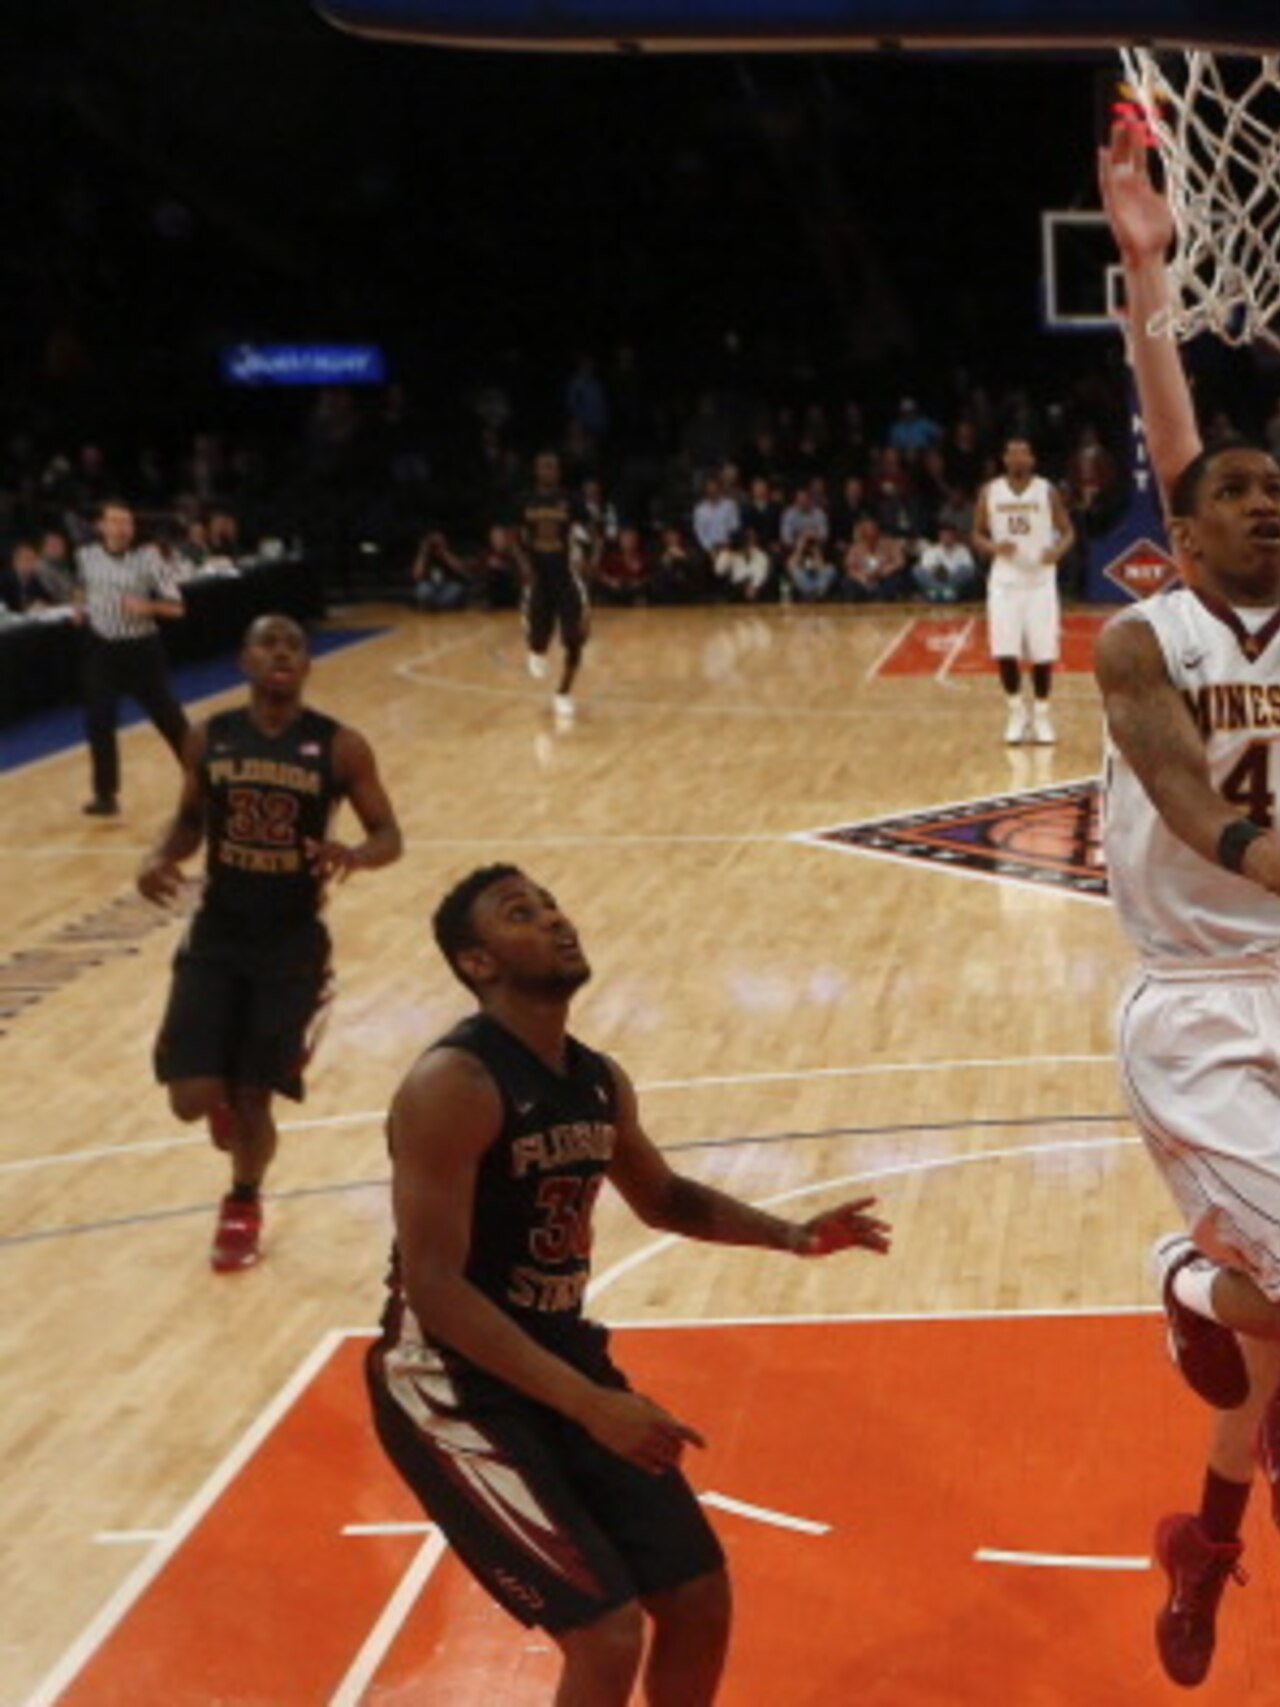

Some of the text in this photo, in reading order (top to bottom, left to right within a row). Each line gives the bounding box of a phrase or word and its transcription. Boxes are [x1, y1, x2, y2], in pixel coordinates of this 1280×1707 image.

[209, 757, 320, 795] FLORIDA
[1221, 742, 1276, 828] 4
[228, 787, 299, 846] 32
